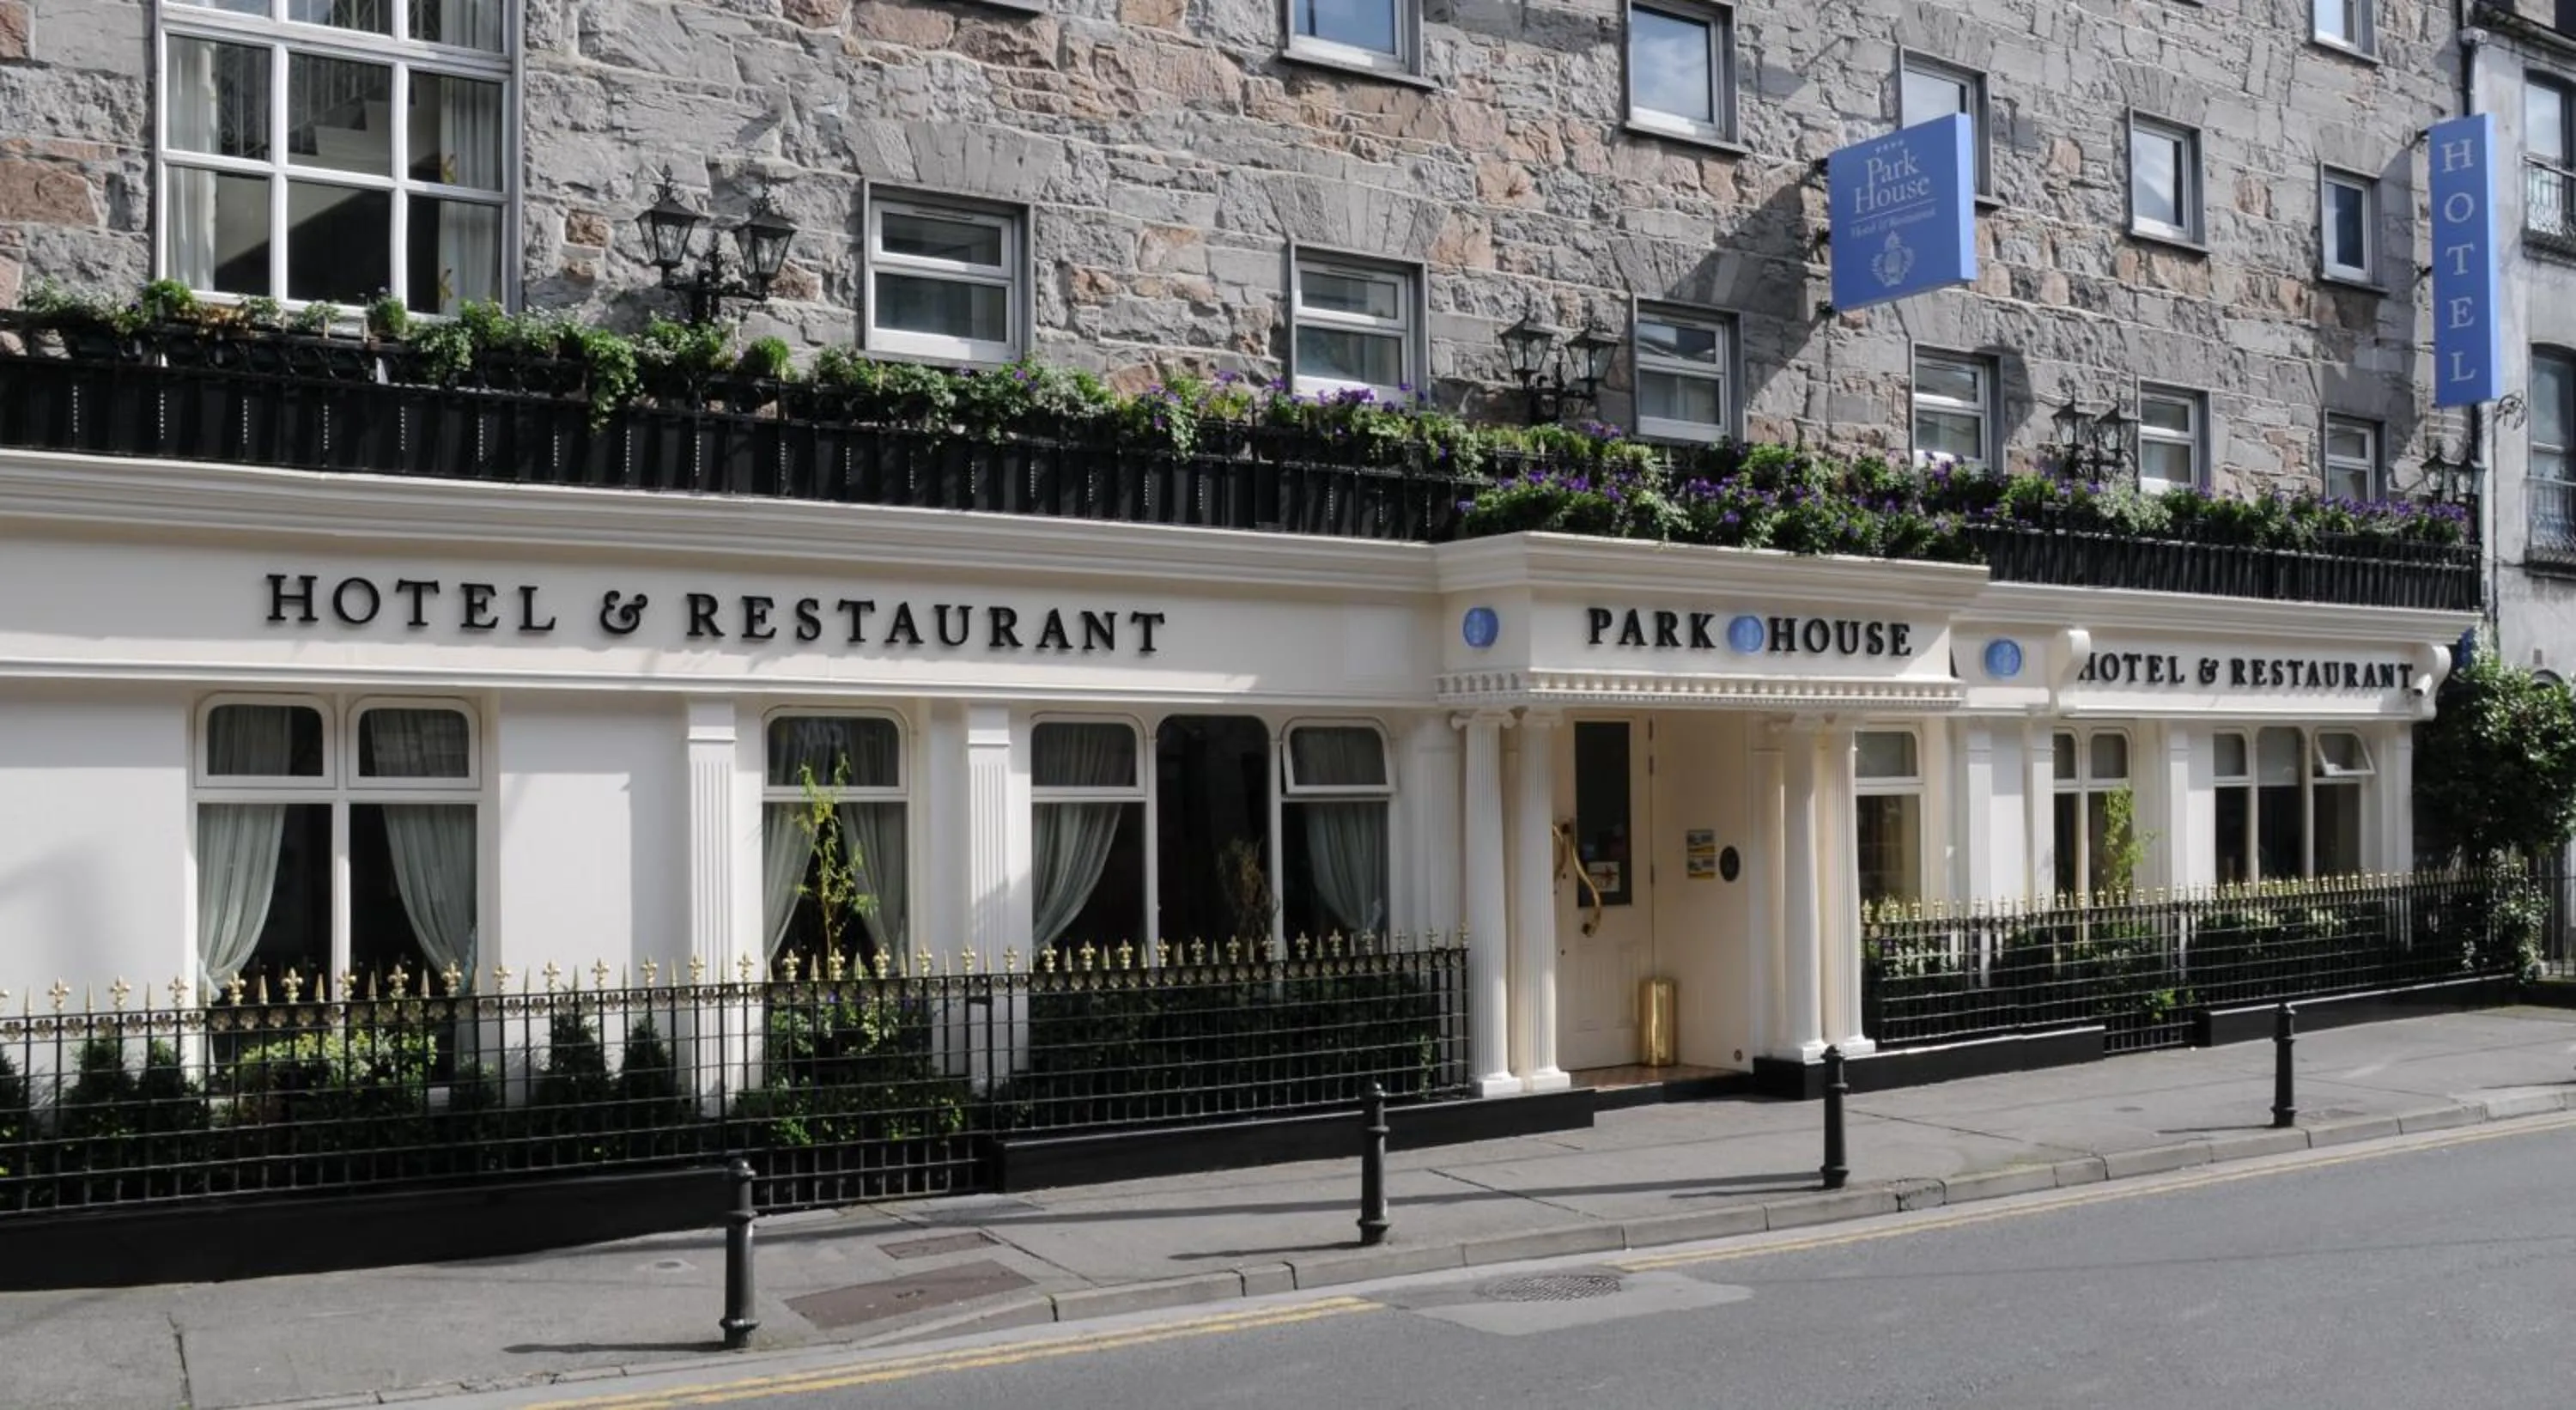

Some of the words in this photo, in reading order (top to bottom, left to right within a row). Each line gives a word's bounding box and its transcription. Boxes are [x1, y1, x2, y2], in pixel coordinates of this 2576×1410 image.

[1865, 148, 1920, 184] Park
[1854, 177, 1930, 214] House
[2440, 138, 2476, 382] HOTEL
[266, 574, 556, 631] HOTEL
[599, 589, 648, 635] &
[686, 593, 1165, 652] RESTAURANT
[1587, 607, 1716, 649] PARK
[1768, 617, 1912, 657] HOUSE
[2197, 656, 2221, 685] &
[2229, 658, 2414, 690] RESTAURANT
